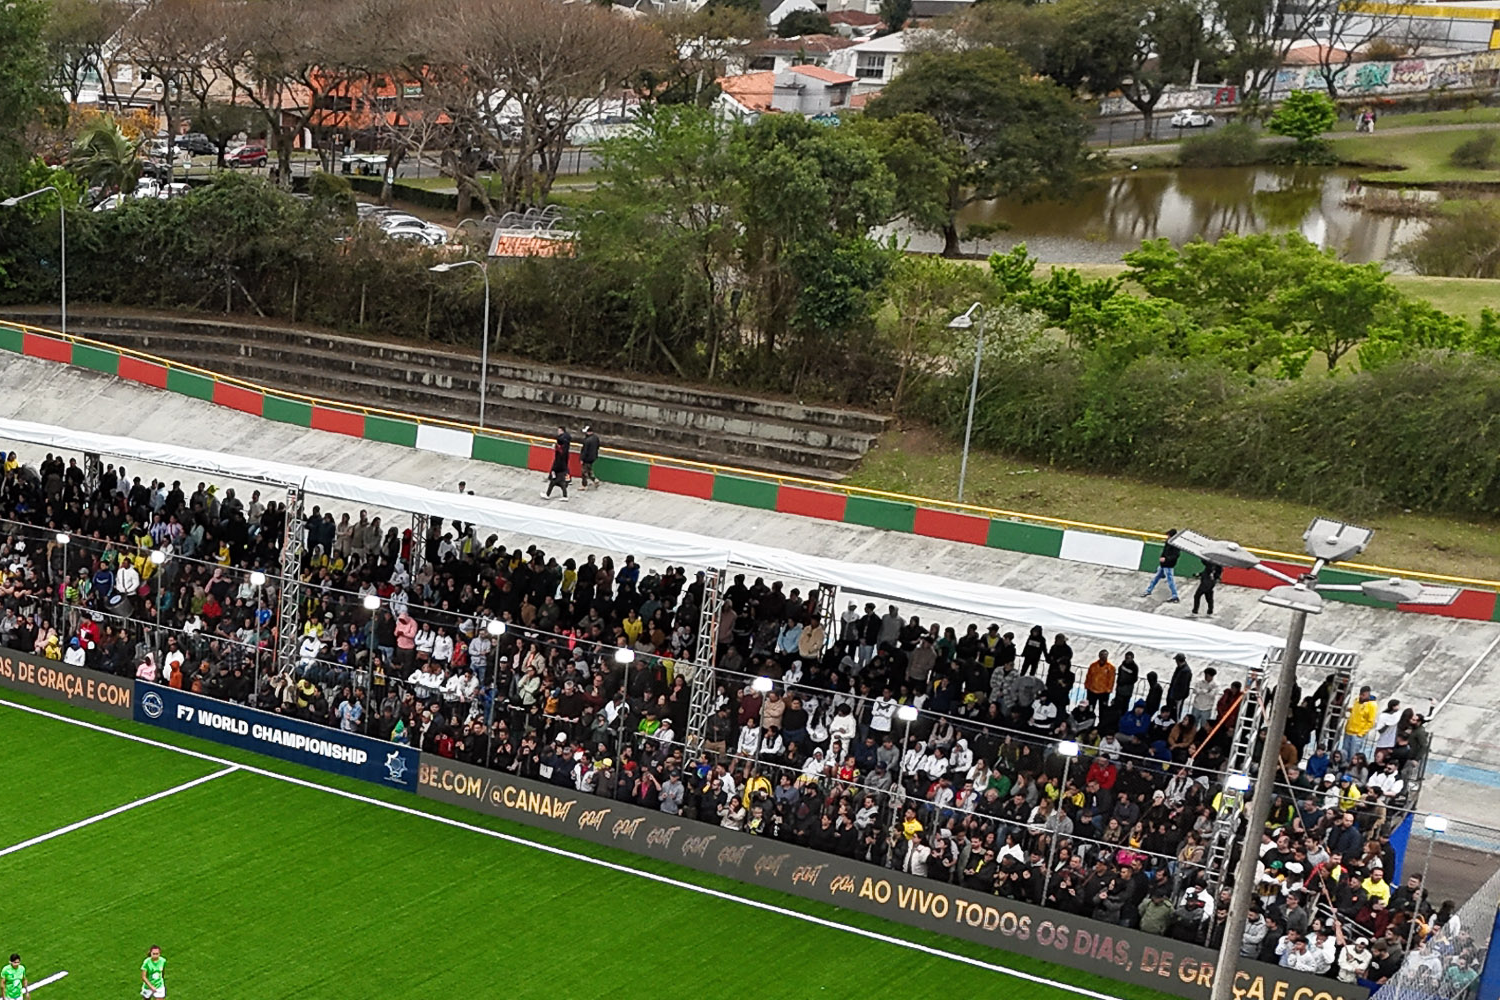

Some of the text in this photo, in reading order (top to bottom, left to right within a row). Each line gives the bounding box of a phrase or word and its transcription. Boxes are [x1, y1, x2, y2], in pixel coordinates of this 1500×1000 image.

[18, 662, 35, 684] DE
[37, 668, 83, 698] GRAÇA
[87, 680, 94, 699] E
[97, 683, 131, 708] COM
[177, 704, 368, 765] F7 WORLD CHAMPIONSHIP
[578, 809, 611, 831] GOAT
[612, 817, 646, 840] GOAT
[858, 876, 892, 904] AO
[897, 885, 949, 918] VIVO
[955, 900, 1032, 940] TODOS
[1036, 920, 1069, 951] OS
[1074, 929, 1133, 971] DIAS,
[1140, 947, 1172, 977] DE
